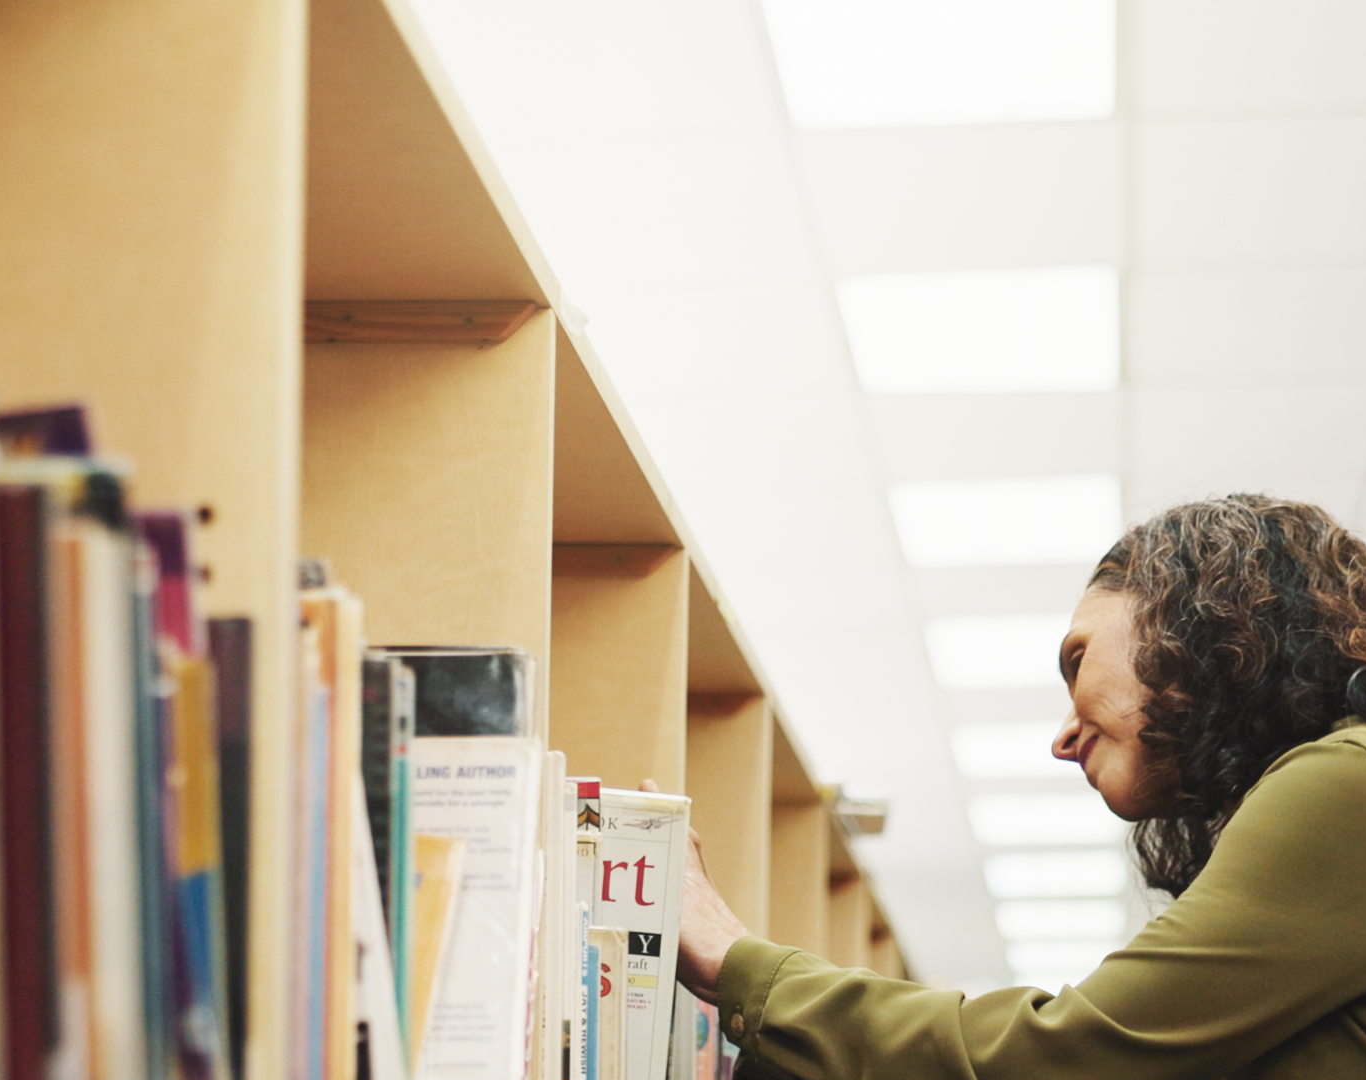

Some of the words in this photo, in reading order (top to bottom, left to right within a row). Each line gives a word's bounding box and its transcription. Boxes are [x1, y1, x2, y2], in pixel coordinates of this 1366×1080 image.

[456, 766, 516, 779] AUTHOR
[601, 855, 655, 906] rt
[638, 934, 654, 954] Y
